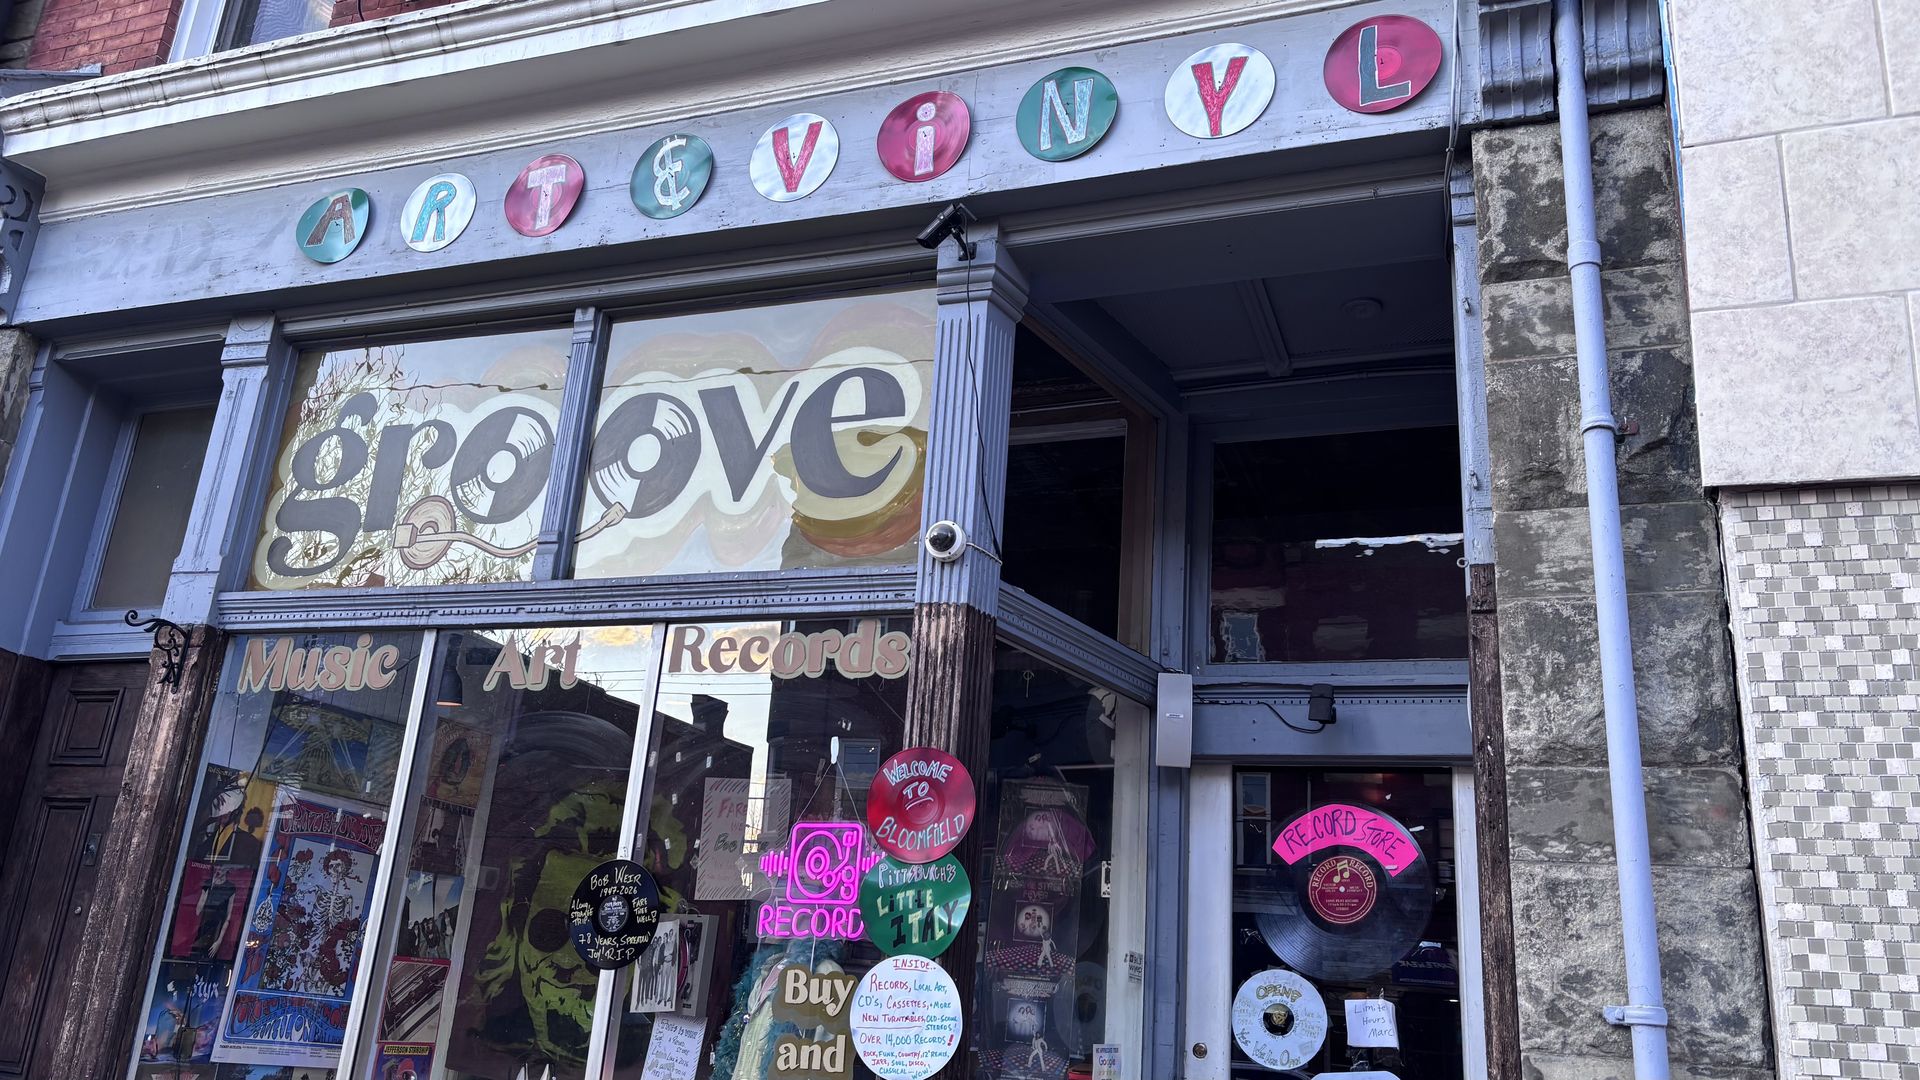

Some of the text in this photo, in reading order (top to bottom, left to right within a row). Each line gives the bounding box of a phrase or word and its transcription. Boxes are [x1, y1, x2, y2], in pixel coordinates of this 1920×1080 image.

[303, 164, 566, 248] ART
[652, 135, 691, 212] &
[268, 366, 907, 578] groove
[483, 630, 583, 692] Art
[669, 620, 911, 679] Records
[237, 633, 401, 694] Music
[883, 759, 954, 786] WELCOME
[902, 781, 931, 800] TO
[1282, 808, 1406, 860] RECORD STORE
[590, 865, 642, 890] BOB WEIR
[1311, 859, 1337, 888] RECORD
[1349, 859, 1374, 889] RECORD
[600, 886, 638, 897] 1947-2026
[632, 897, 648, 908] FARE
[758, 904, 865, 938] RECORD
[890, 899, 959, 948] ITALY
[578, 932, 591, 944] 78
[786, 970, 856, 1017] Buy
[913, 979, 933, 991] LOCAL
[862, 1013, 879, 1022] NEW
[1354, 1004, 1387, 1015] Limite
[1362, 1016, 1386, 1026] Hours
[860, 1033, 881, 1045] OVER
[885, 1034, 912, 1048] 14,000
[1367, 1028, 1394, 1039] Marc
[778, 1034, 846, 1073] and
